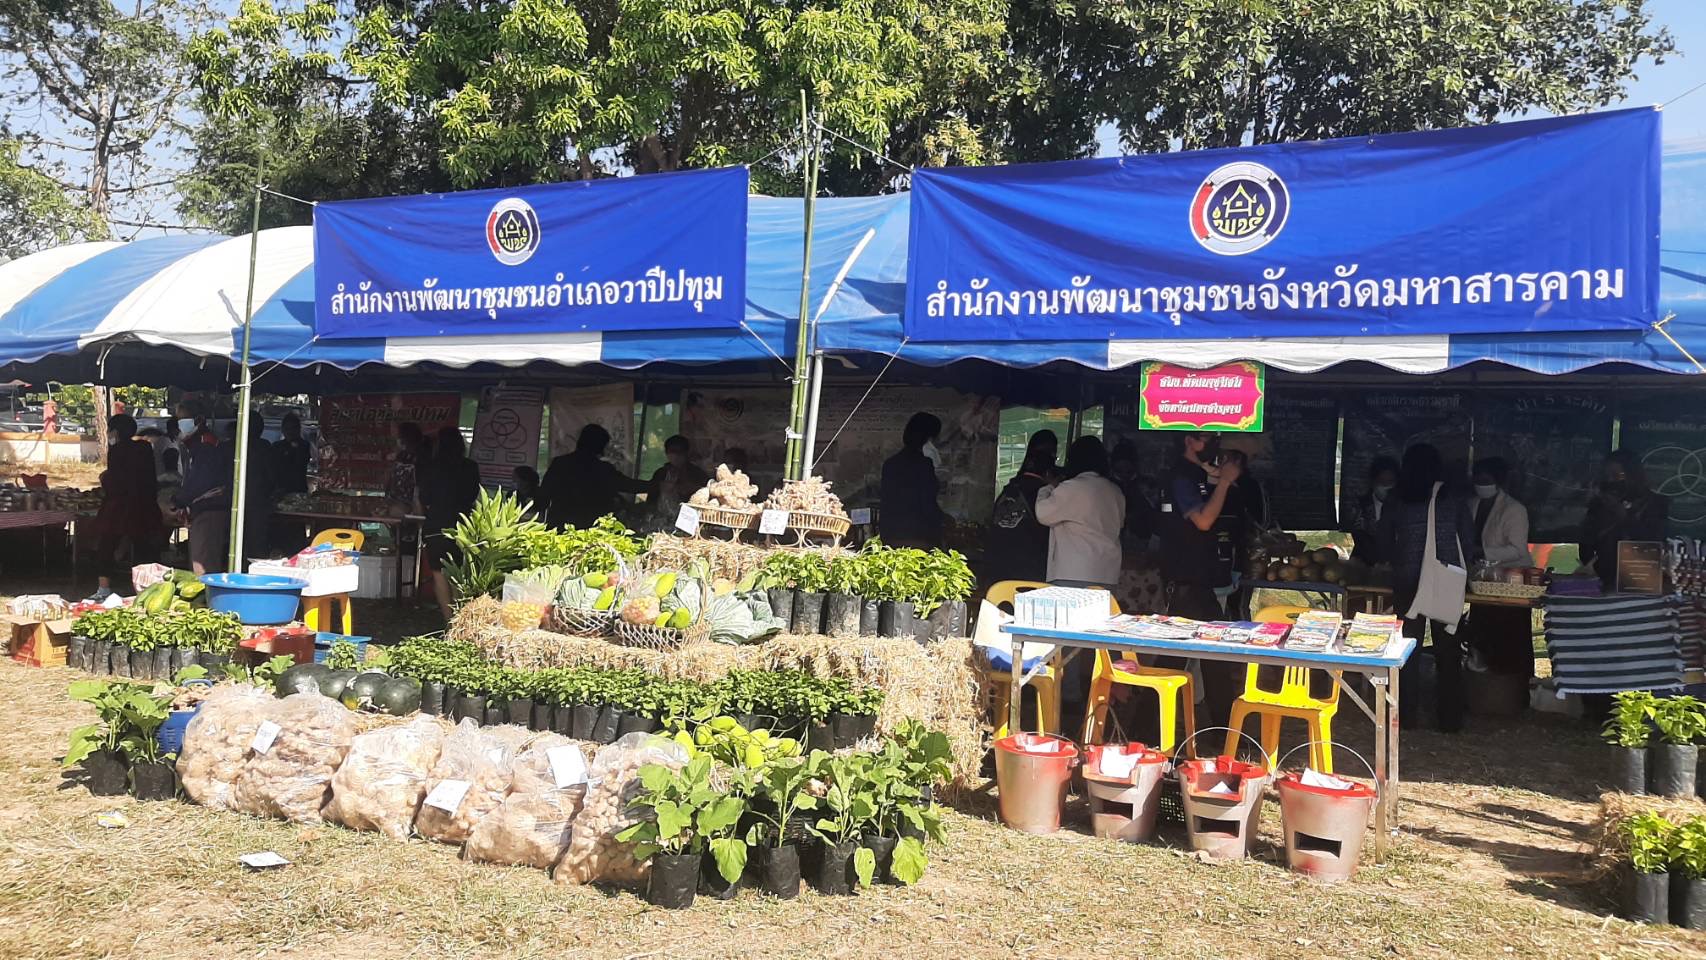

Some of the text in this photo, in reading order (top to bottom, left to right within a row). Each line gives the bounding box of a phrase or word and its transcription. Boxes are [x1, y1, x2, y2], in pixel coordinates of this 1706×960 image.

[331, 266, 723, 318] สำนักงานพัฒนาชุมชนอำเภอวาปีปทุม
[926, 264, 1624, 325] สำนักงานพัฒนาชุมชนจังหวัดมหาสารคาม
